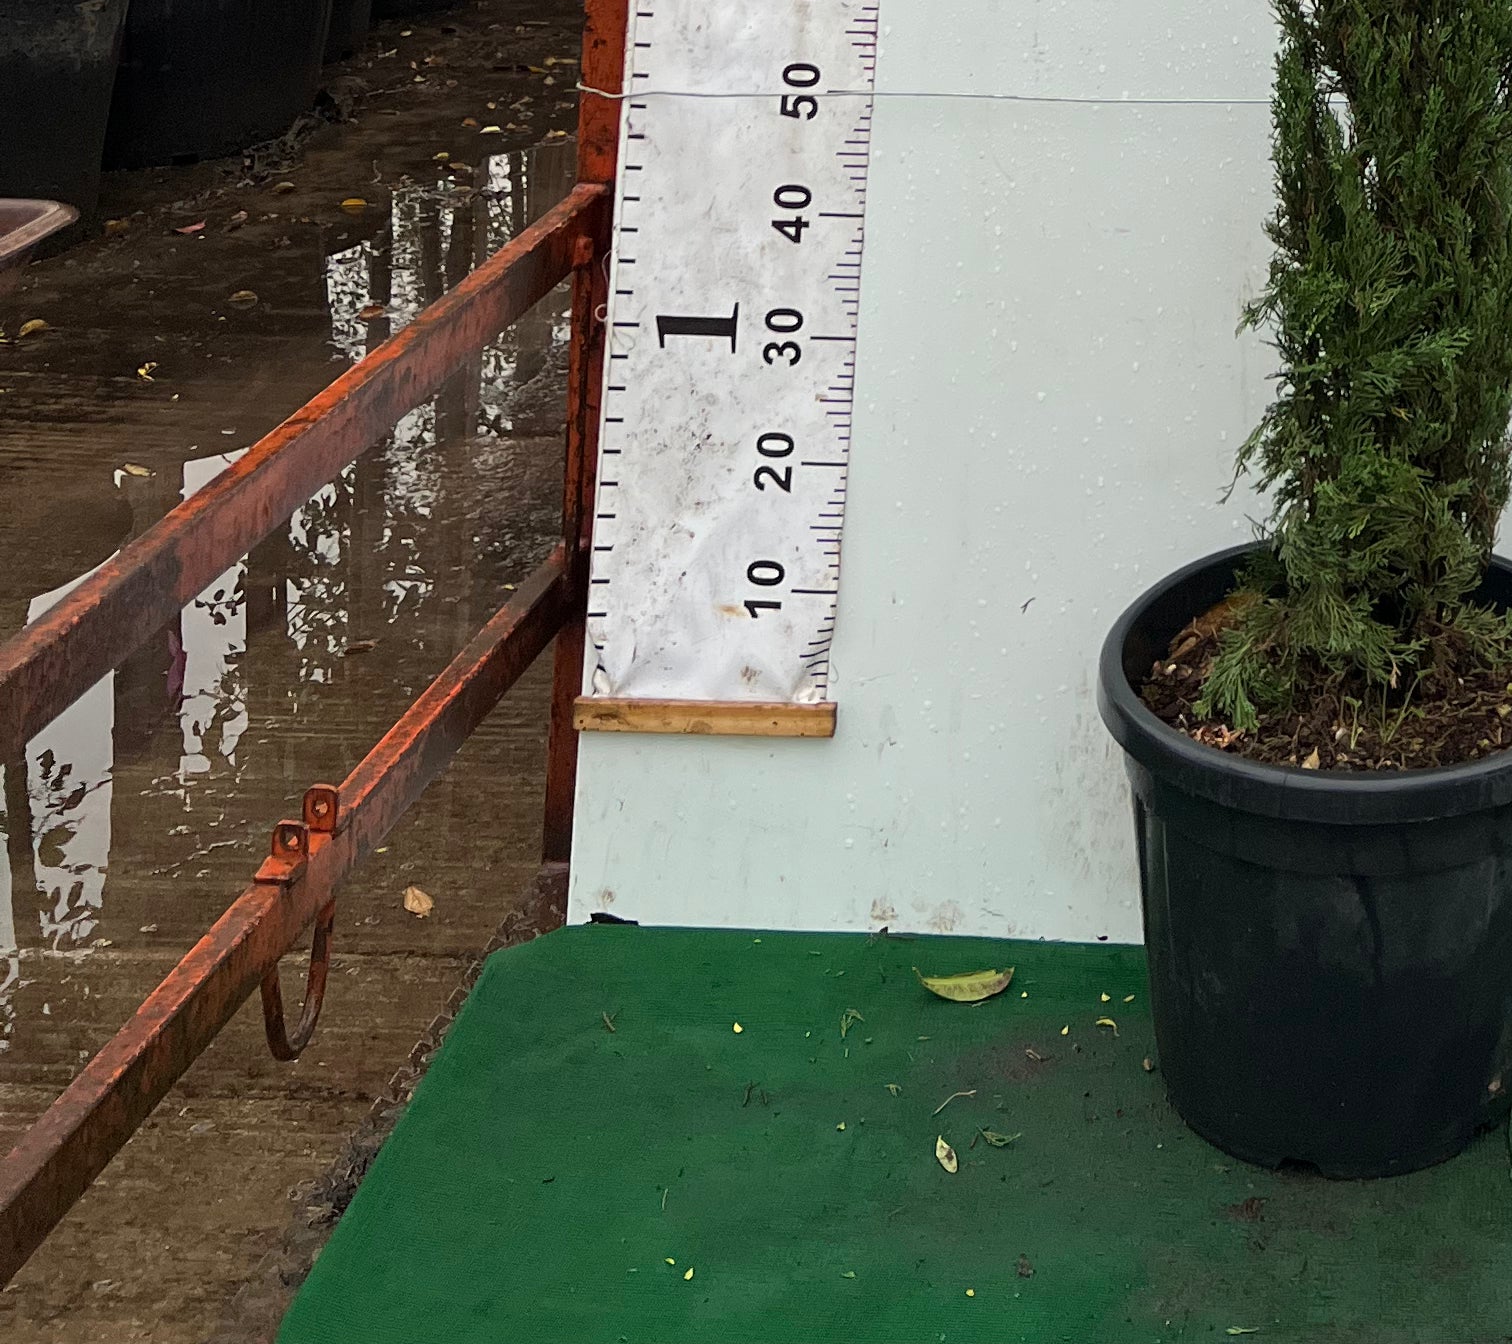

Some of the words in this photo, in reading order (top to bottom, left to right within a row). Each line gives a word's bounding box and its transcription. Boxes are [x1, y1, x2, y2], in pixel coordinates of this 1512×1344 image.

[779, 63, 821, 121] 50
[771, 184, 812, 244] 40
[655, 301, 739, 354] 1
[762, 308, 804, 367] 30
[753, 432, 795, 493] 20
[743, 560, 785, 619] 10
